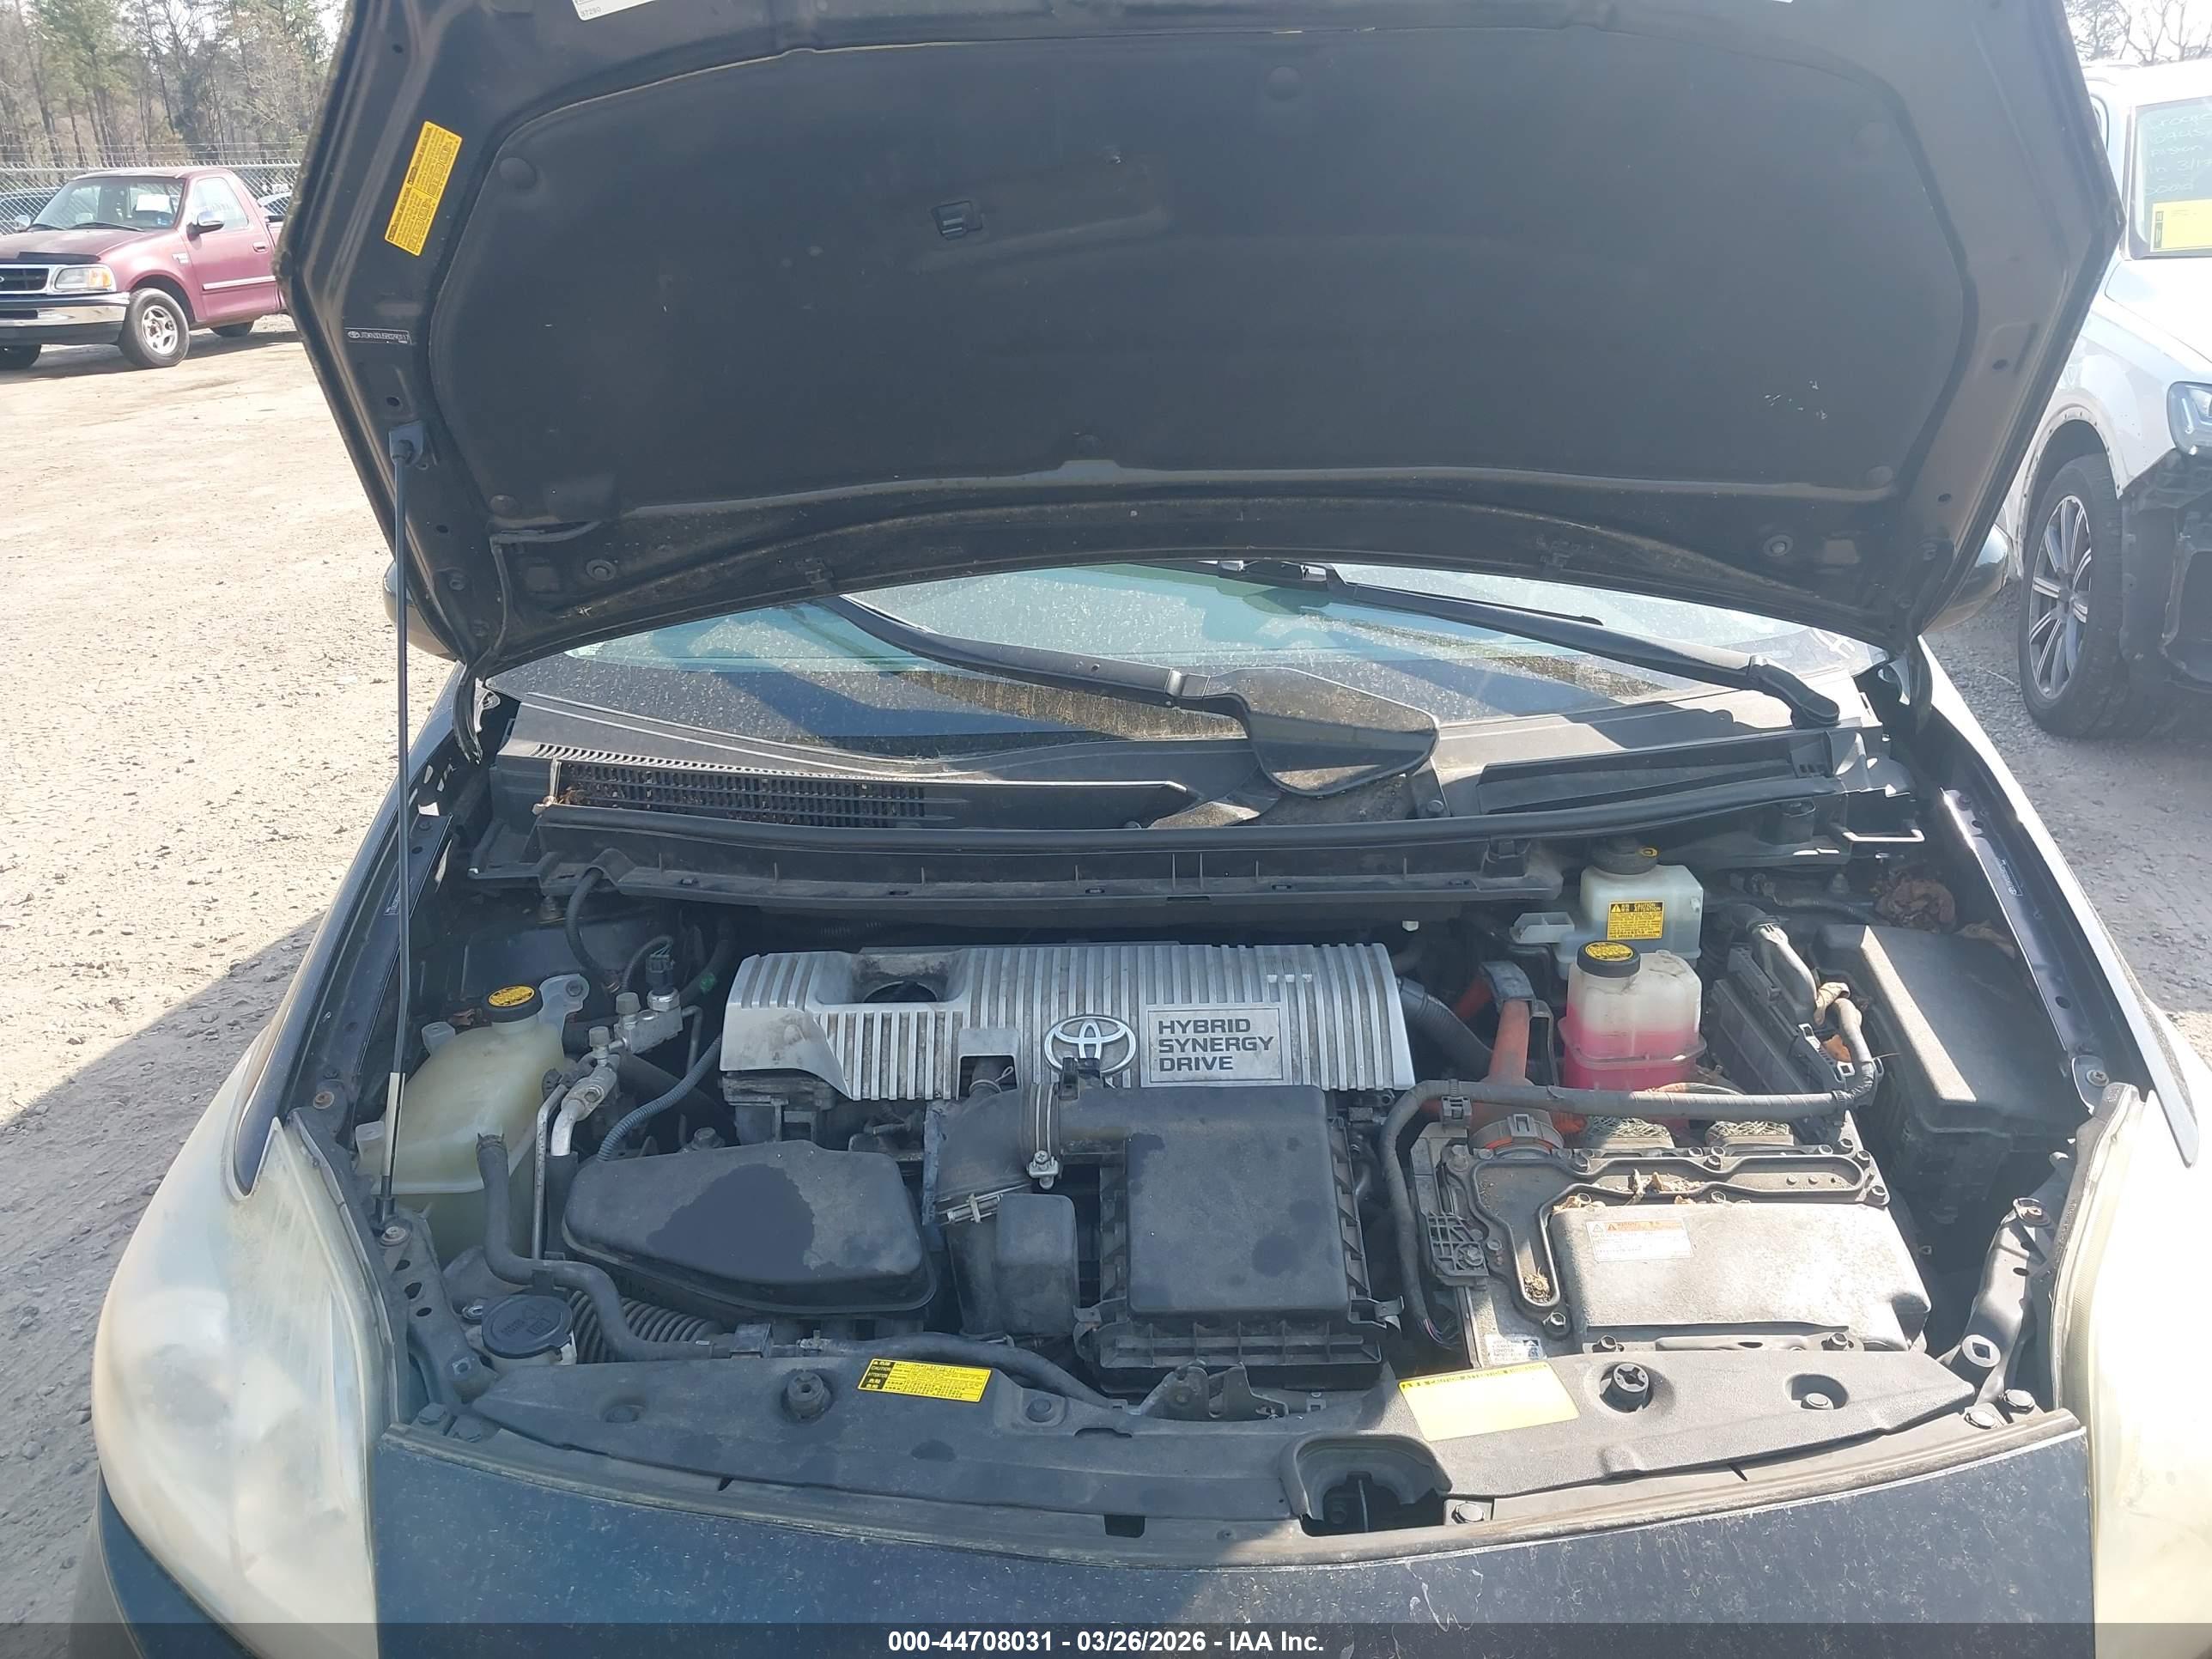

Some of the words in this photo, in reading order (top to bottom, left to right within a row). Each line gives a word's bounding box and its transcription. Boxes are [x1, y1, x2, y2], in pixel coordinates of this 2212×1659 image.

[1158, 1018, 1251, 1035] HYBRID
[1158, 1036, 1274, 1054] SYNERGY
[1159, 1055, 1234, 1073] DRIVE
